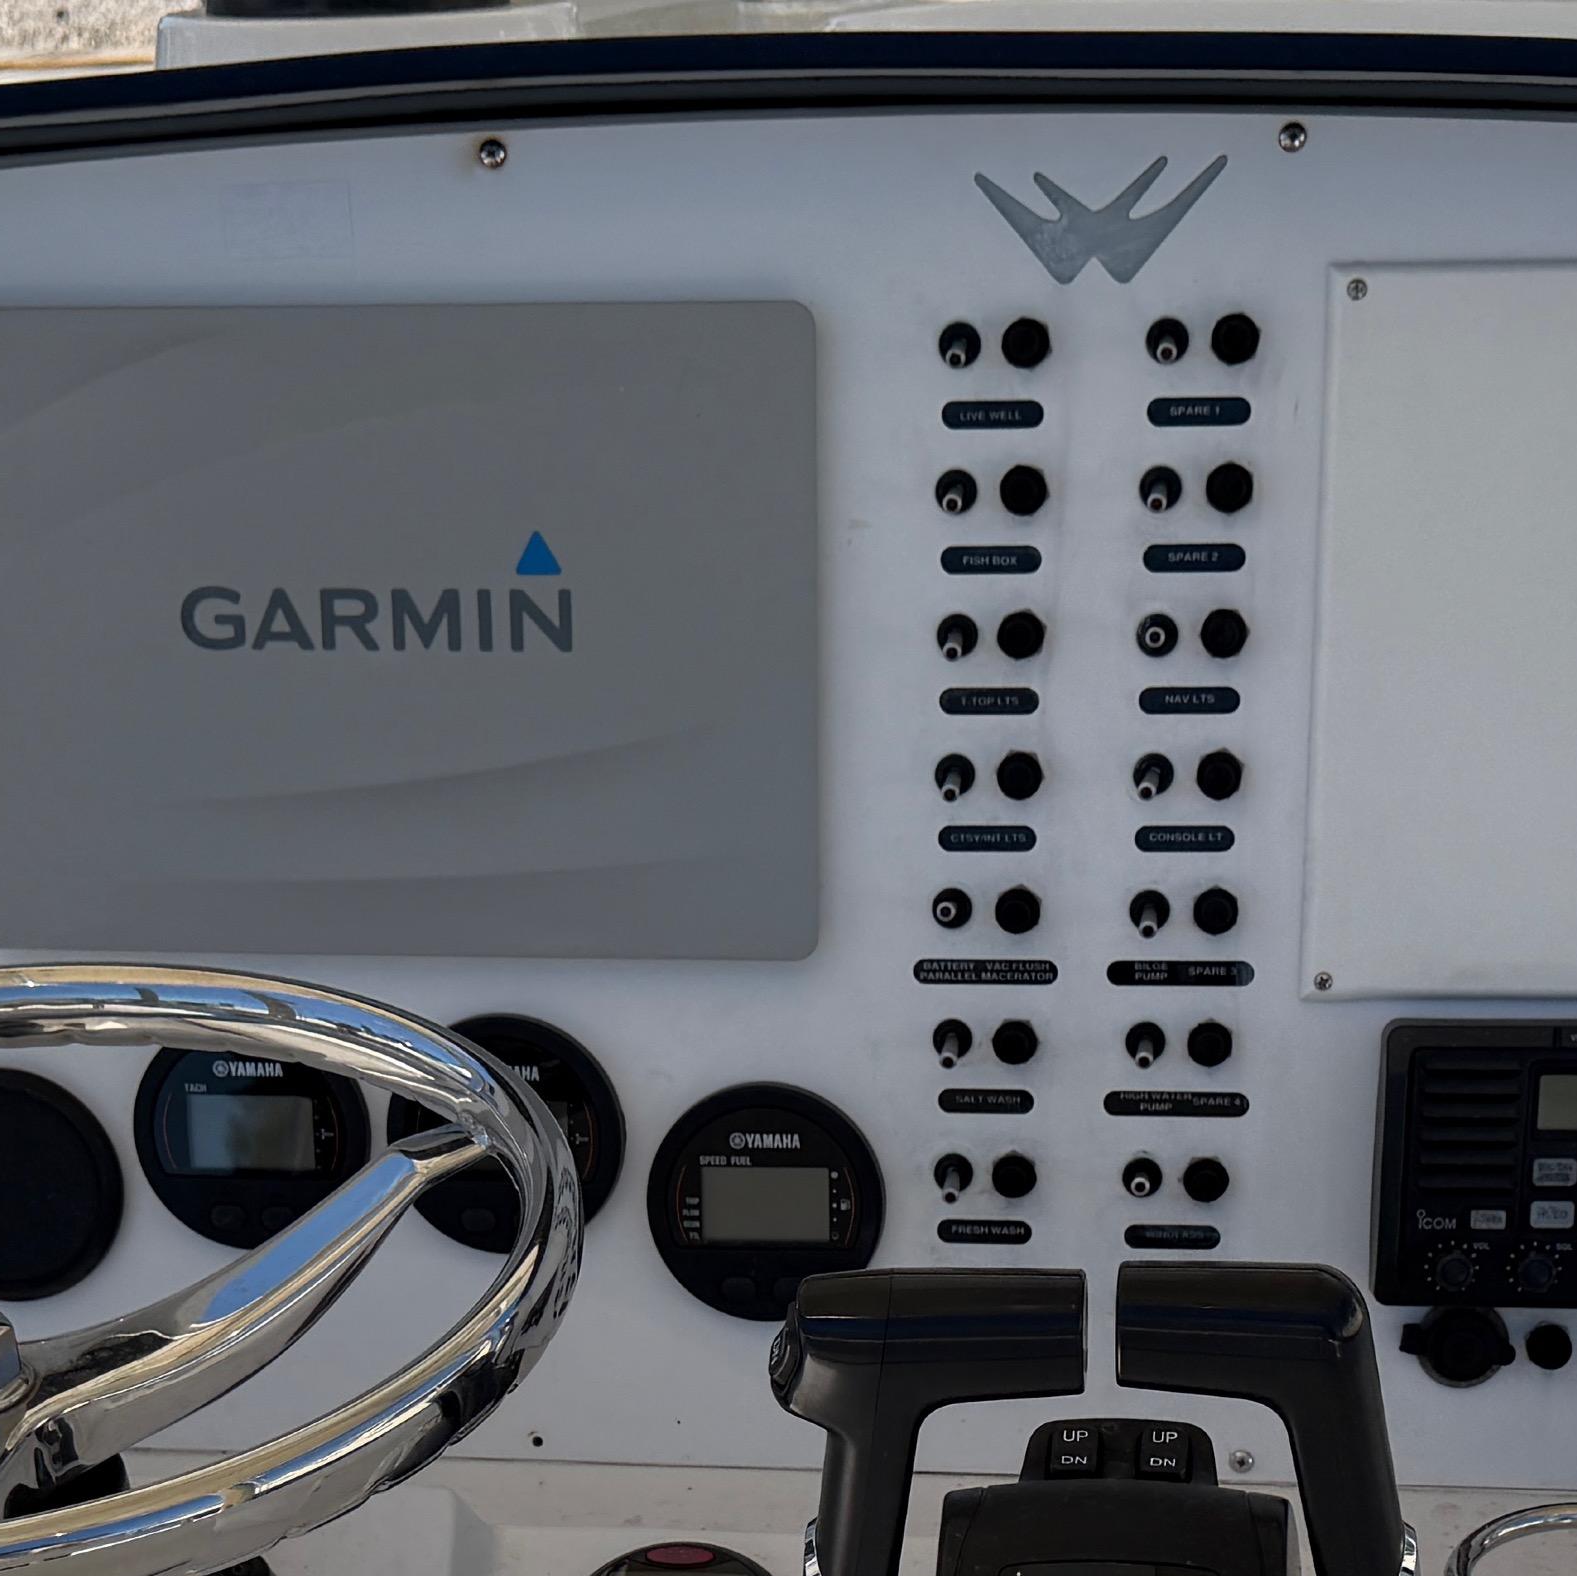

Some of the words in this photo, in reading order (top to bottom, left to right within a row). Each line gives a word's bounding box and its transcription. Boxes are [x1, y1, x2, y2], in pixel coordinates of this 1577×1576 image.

[959, 409, 984, 421] LIVE
[988, 409, 1021, 421] WELL
[1170, 405, 1210, 416] SPARE
[1215, 405, 1220, 415] 1
[963, 555, 990, 566] FISH
[992, 555, 1017, 566] BOX
[1168, 552, 1209, 562] SPARE
[1212, 552, 1218, 562] 2
[180, 585, 573, 653] GARMIN
[1165, 693, 1190, 704] NAV
[1192, 693, 1215, 704] LTS
[1149, 831, 1205, 841] CONSOLE
[1209, 832, 1223, 841] LT
[923, 961, 975, 971] BATTERY
[985, 961, 1010, 971] VAC
[1012, 961, 1050, 971] FLUSH
[1188, 966, 1226, 976] SPARE
[919, 971, 976, 981] PARALLEL
[981, 971, 1054, 981] MACERATOR
[1134, 971, 1168, 981] PUMP
[229, 1061, 284, 1078] YAMAHA
[955, 1095, 983, 1104] SALT
[986, 1095, 1021, 1104] WASH
[1192, 1096, 1230, 1107] SPARE
[1139, 1102, 1173, 1111] PUMP
[745, 1133, 801, 1150] YAMAHA
[699, 1155, 727, 1166] SPEED
[730, 1155, 752, 1166] FUEL
[951, 1224, 988, 1235] FRESH
[990, 1225, 1024, 1235] WASH
[1063, 1429, 1089, 1442] UP
[1153, 1431, 1178, 1443] UP
[1061, 1455, 1088, 1465] DN
[1150, 1457, 1176, 1467] DN
